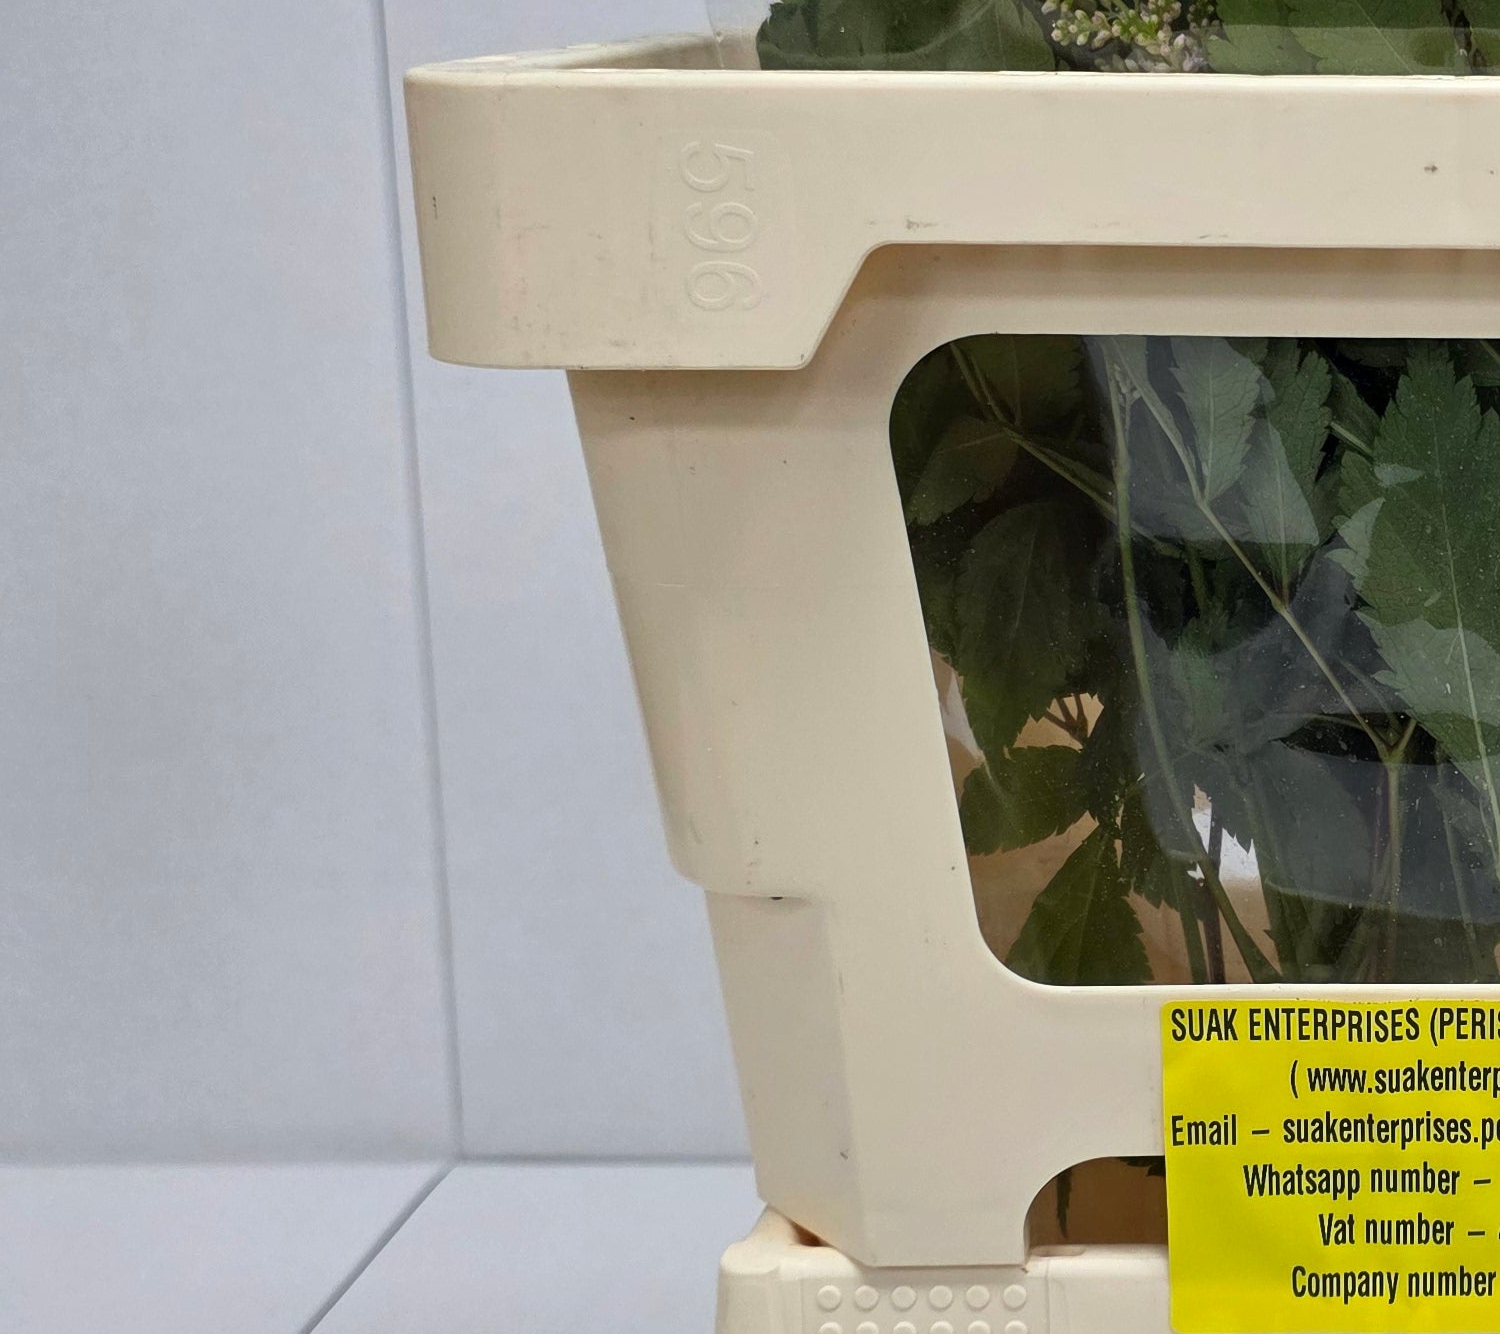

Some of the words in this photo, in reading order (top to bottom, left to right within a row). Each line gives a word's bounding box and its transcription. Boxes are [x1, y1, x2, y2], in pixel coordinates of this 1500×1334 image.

[680, 140, 763, 312] 596
[1171, 1008, 1238, 1042] SUAK
[1249, 1007, 1420, 1043] ENTERPRISES
[1171, 1113, 1237, 1147] Email
[1242, 1163, 1361, 1201] Whatsapp
[1370, 1160, 1461, 1196] number
[1318, 1212, 1356, 1246] Vat
[1365, 1211, 1455, 1246] number
[1291, 1265, 1399, 1305] Company
[1407, 1264, 1497, 1298] number
